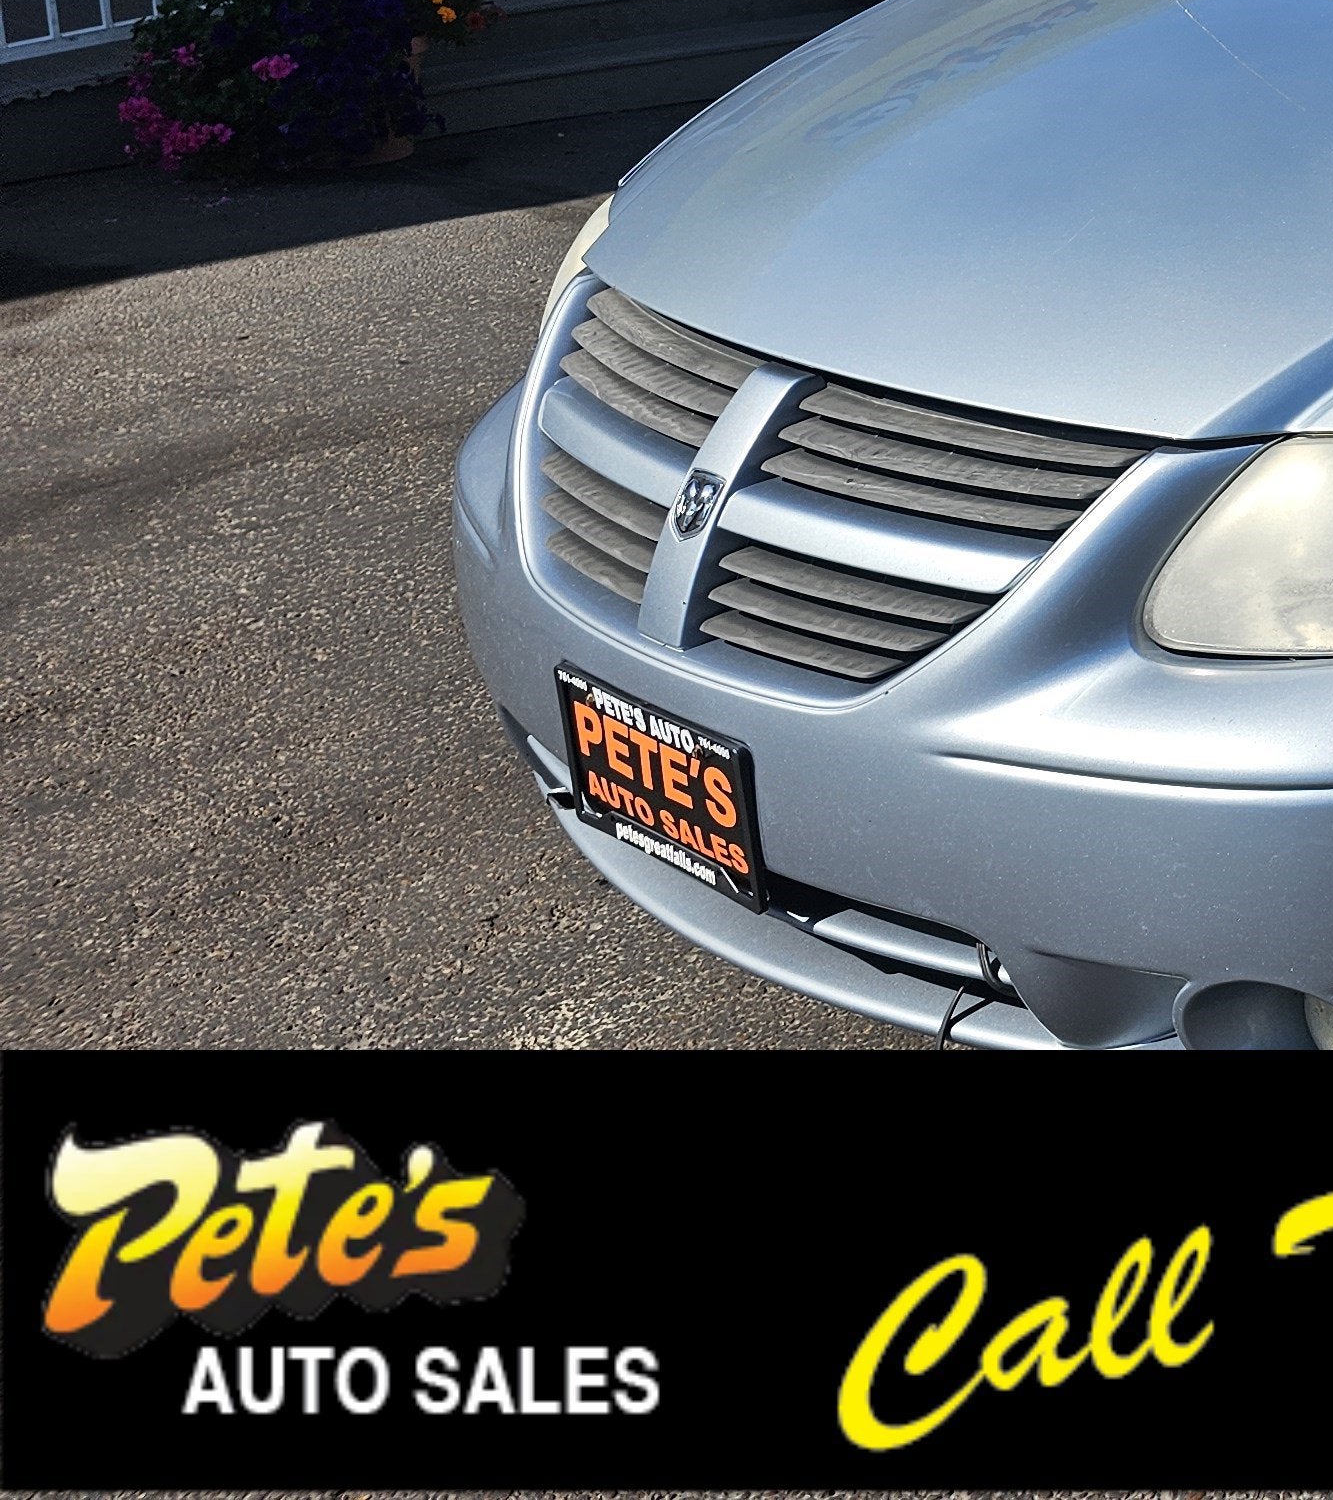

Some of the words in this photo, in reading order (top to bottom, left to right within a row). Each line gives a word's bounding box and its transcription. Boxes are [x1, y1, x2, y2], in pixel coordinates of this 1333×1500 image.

[592, 686, 647, 732] PETE'S
[650, 714, 695, 754] AUTO
[573, 700, 737, 828] PETE'S
[588, 770, 655, 827] AUTO
[659, 809, 749, 875] SALES
[615, 821, 717, 886] petesgreatfalls.com
